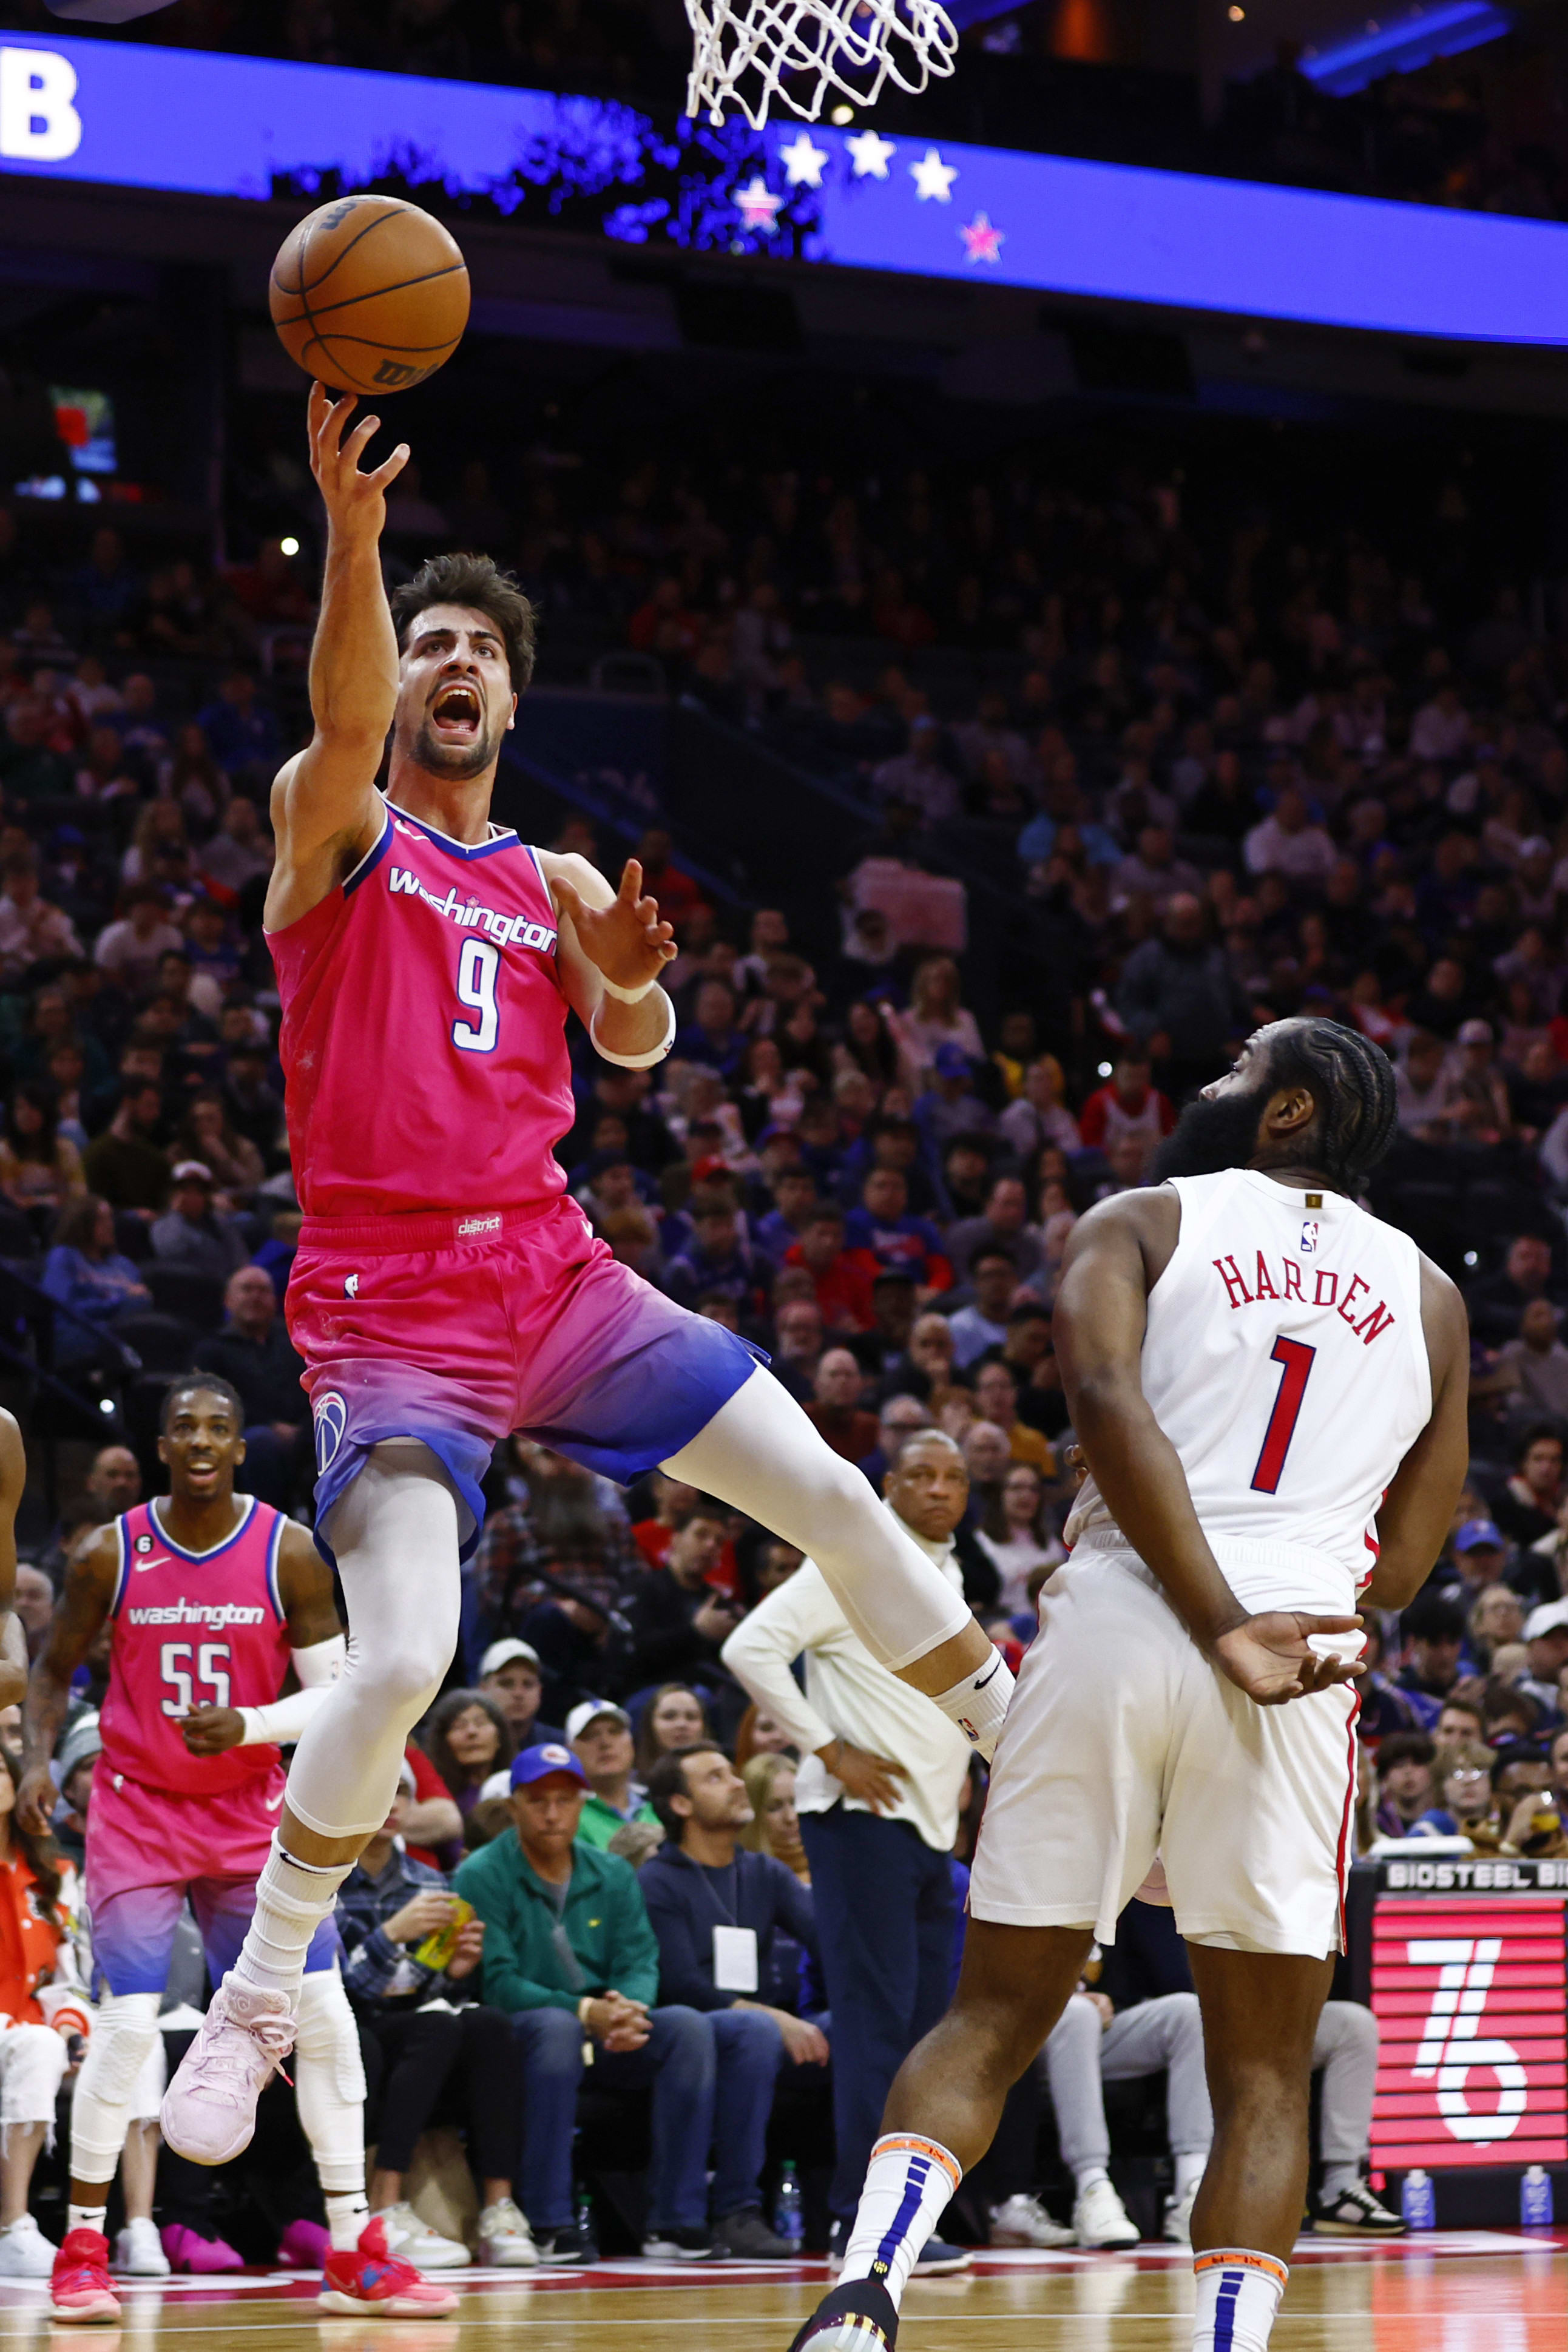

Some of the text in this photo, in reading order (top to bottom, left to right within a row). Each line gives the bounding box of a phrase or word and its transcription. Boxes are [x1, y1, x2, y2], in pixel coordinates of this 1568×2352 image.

[0, 46, 82, 162] B
[451, 936, 502, 1054] 9
[1212, 1250, 1395, 1346] HARDEN
[1250, 1334, 1317, 1495] 1
[138, 1536, 151, 1553] 6
[160, 1642, 231, 1717] 55
[1387, 1864, 1532, 1889] BIOSTEEL
[1406, 1938, 1528, 2149] 76
